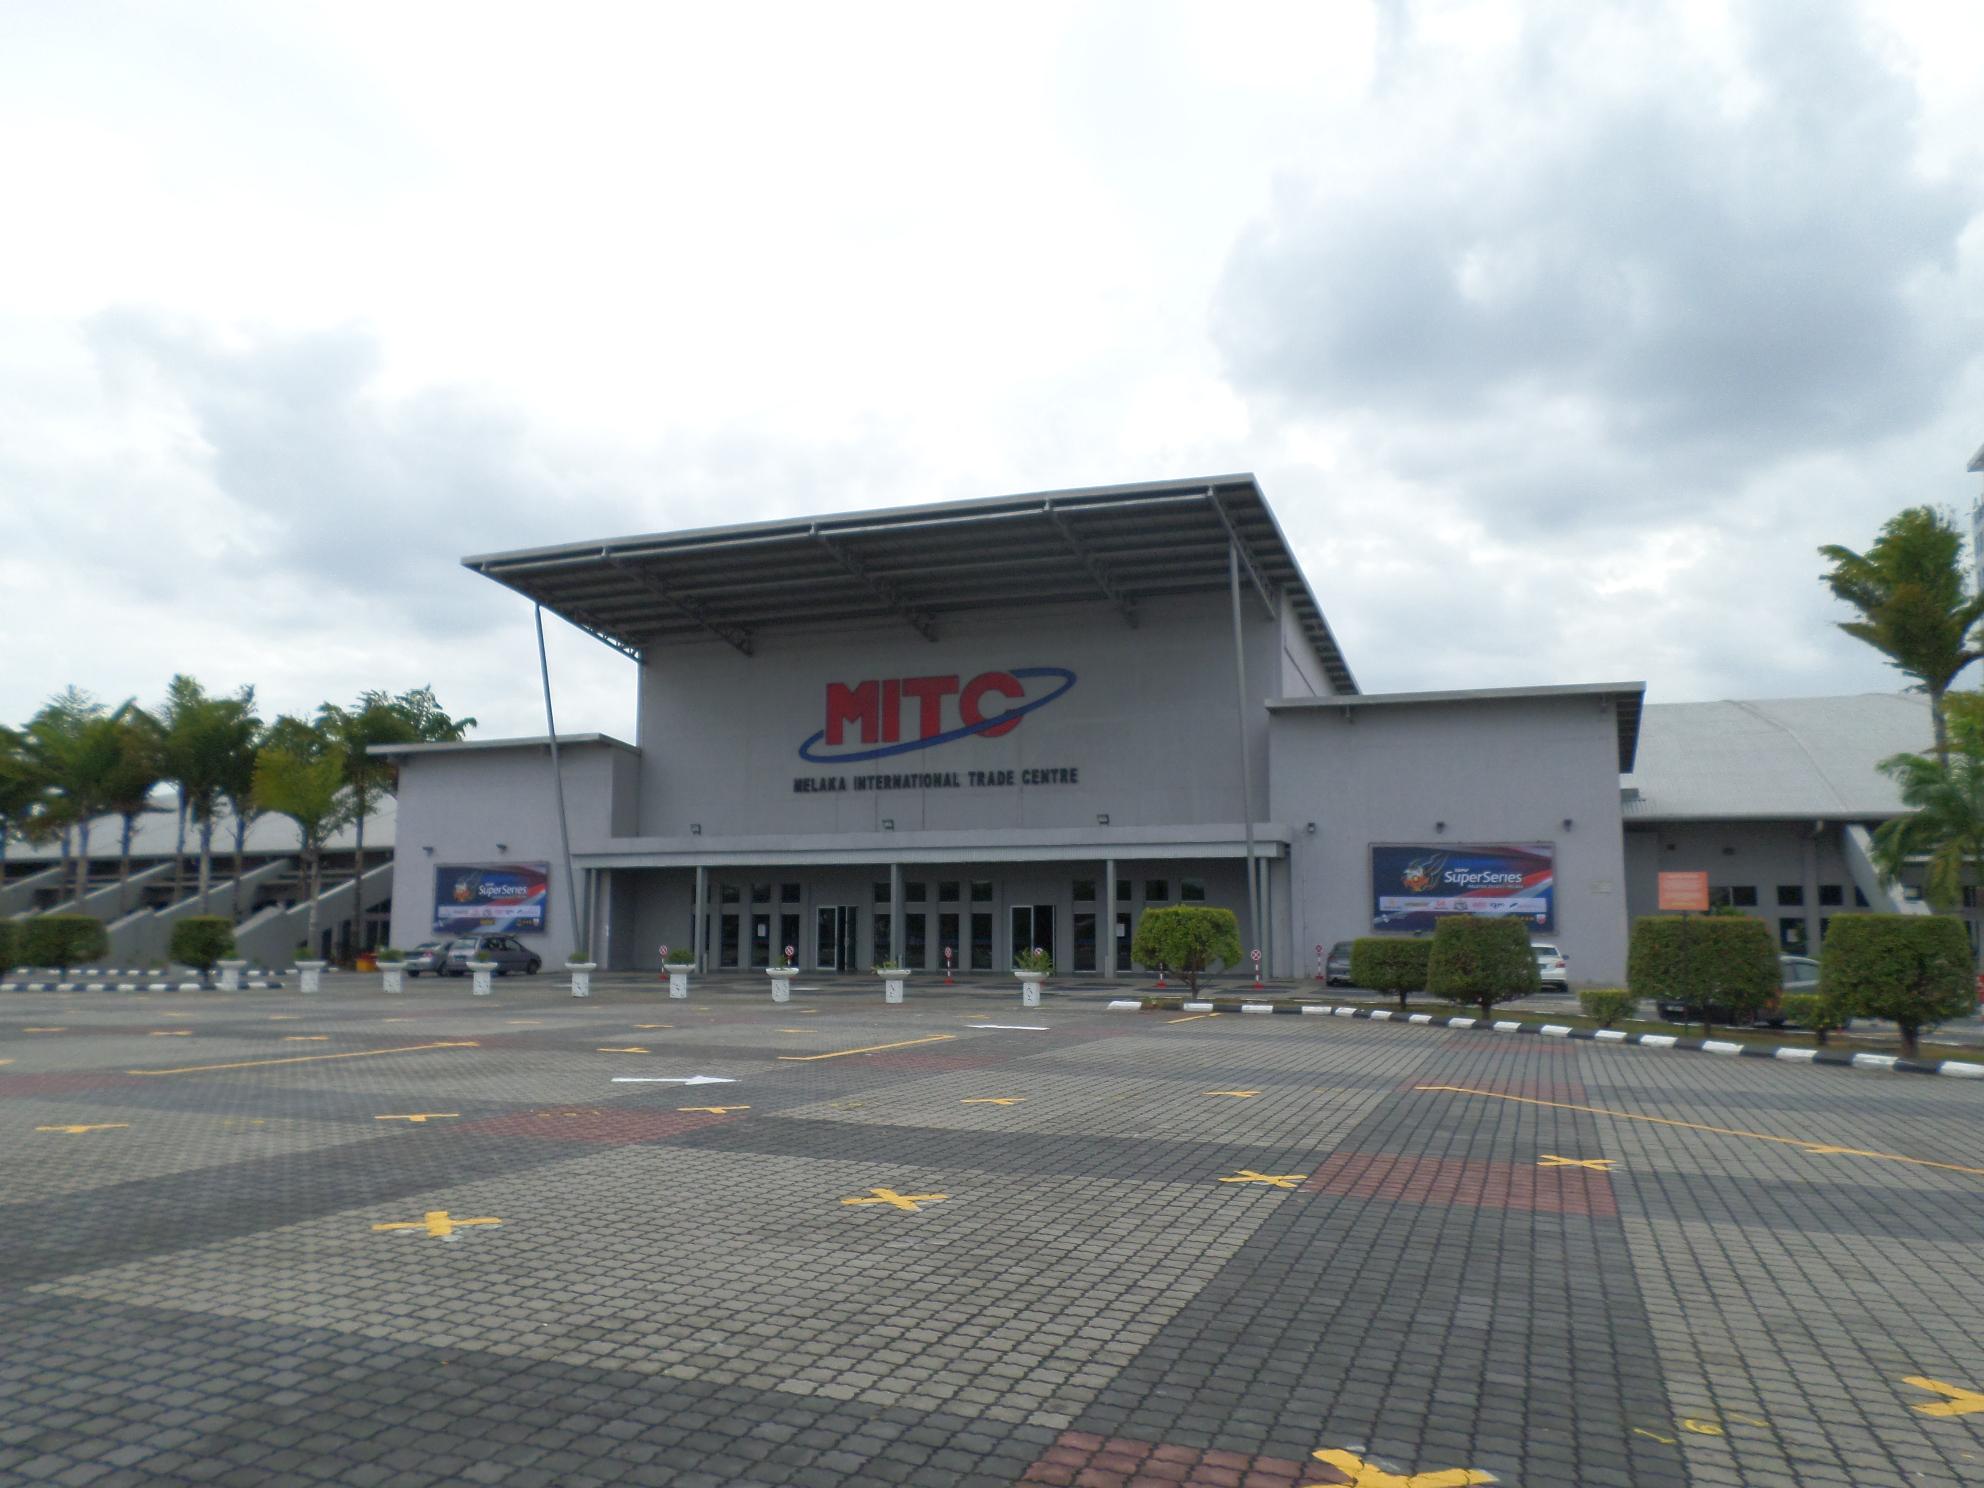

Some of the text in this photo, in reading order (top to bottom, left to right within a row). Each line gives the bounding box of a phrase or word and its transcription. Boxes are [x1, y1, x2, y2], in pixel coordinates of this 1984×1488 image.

[825, 671, 1025, 746] MITC
[793, 768, 1078, 793] MELAKA INTERNATIONAL TRADE CENTRE
